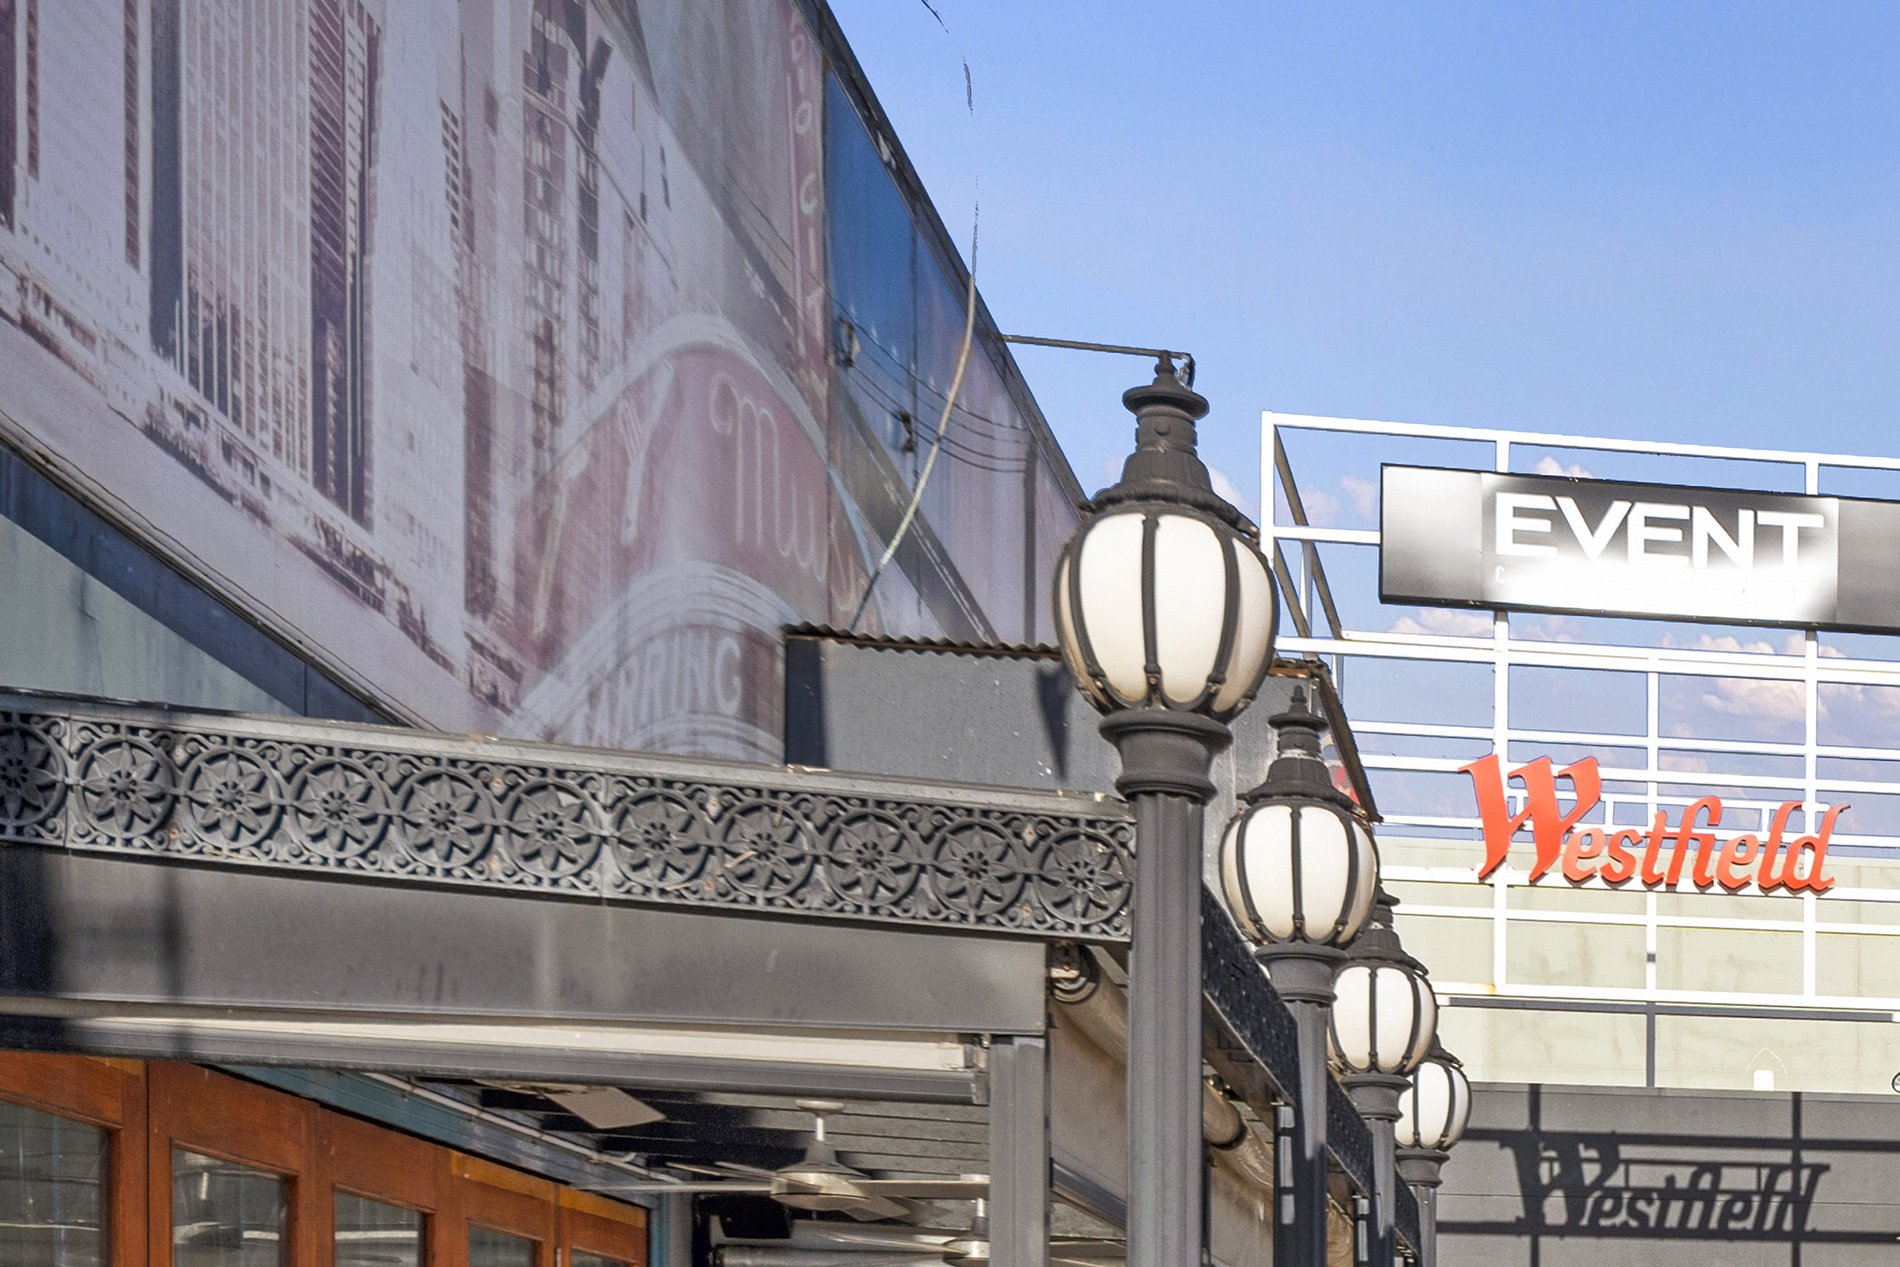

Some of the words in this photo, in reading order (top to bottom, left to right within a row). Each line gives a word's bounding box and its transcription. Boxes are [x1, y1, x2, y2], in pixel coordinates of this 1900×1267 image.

[1495, 492, 1824, 571] EVENT
[1458, 753, 1851, 893] Westfield
[1500, 1134, 1831, 1239] Westfield
